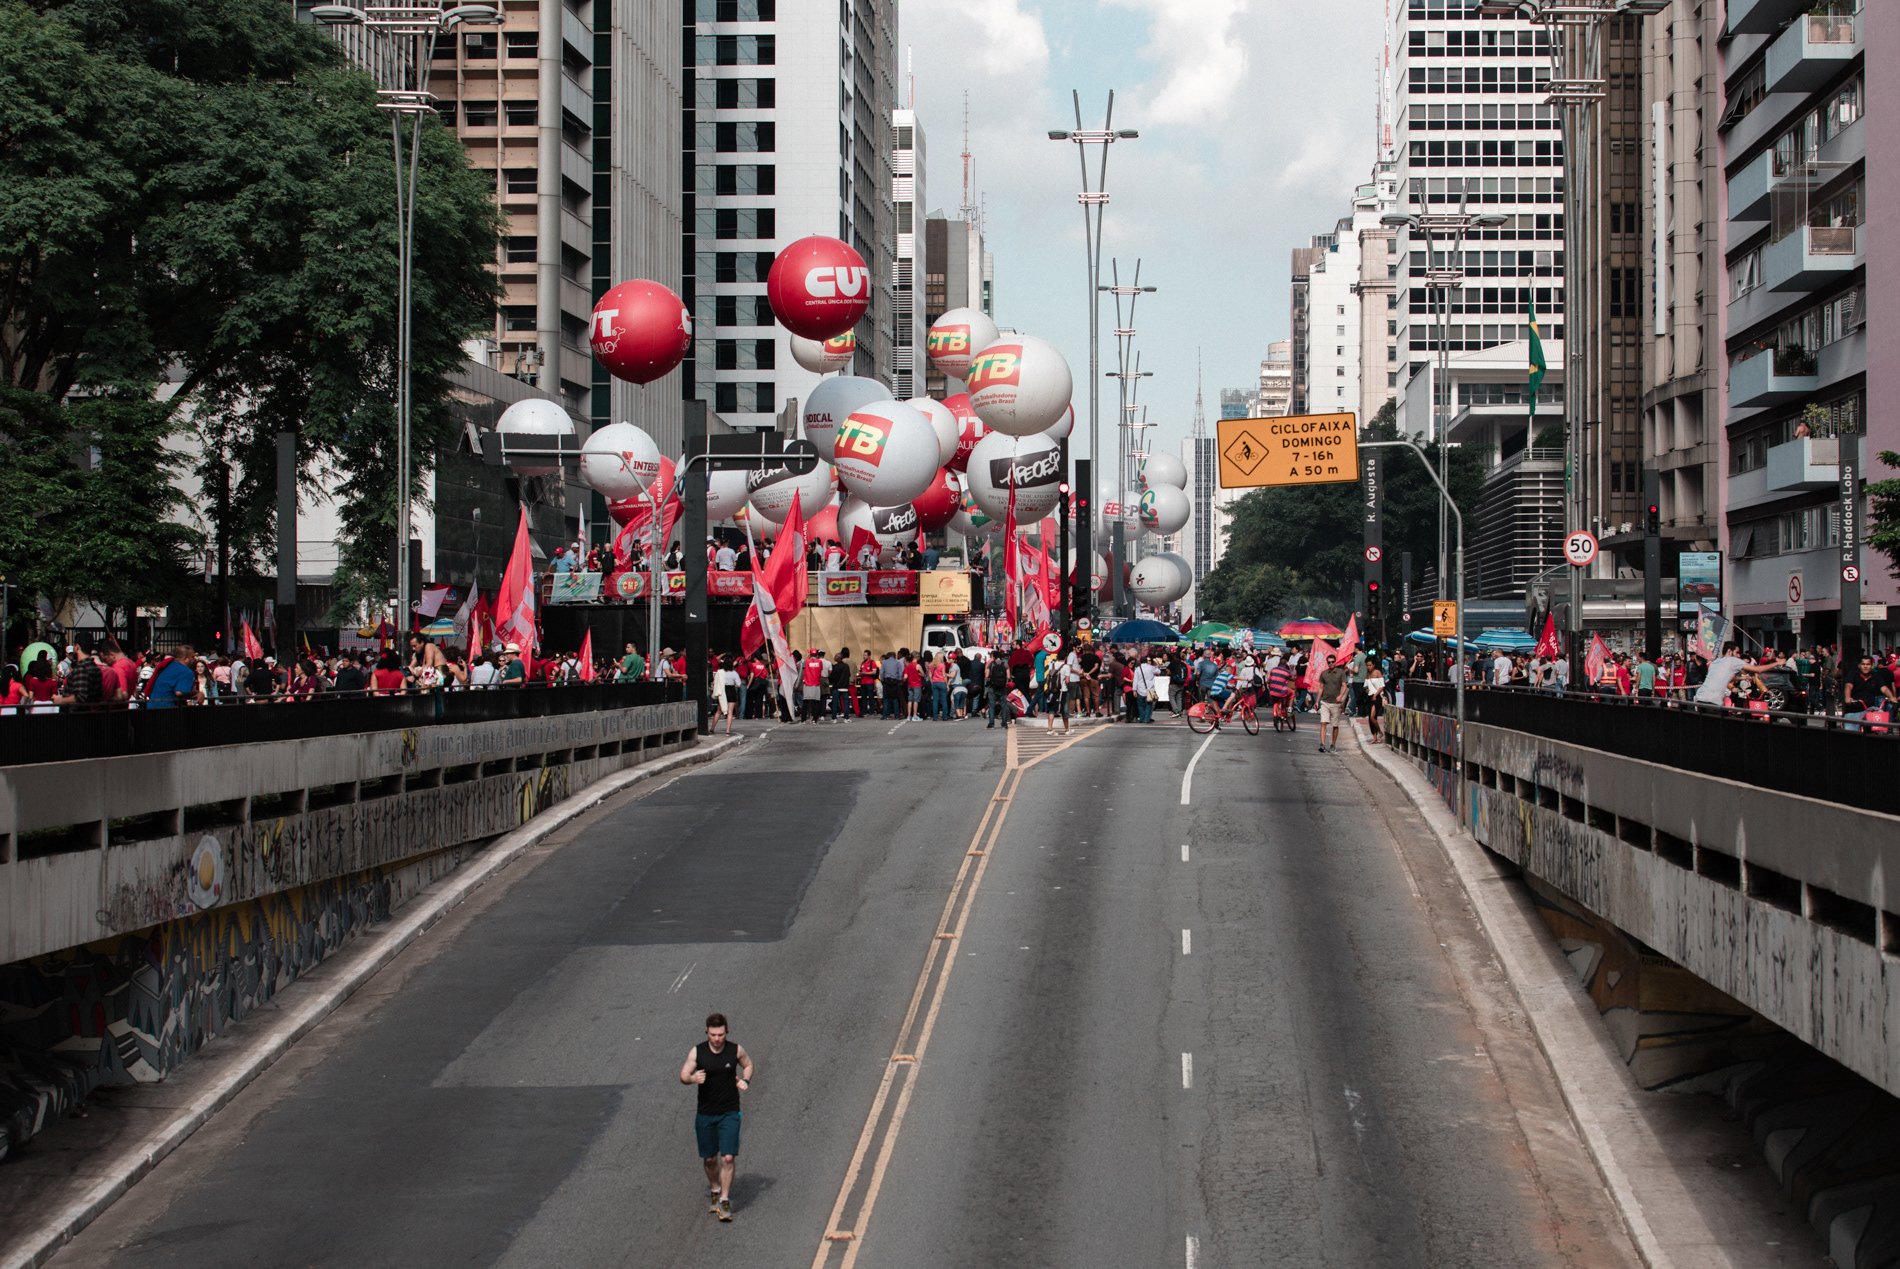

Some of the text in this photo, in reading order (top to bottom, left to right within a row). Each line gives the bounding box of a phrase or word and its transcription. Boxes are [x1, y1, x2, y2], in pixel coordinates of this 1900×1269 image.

[805, 266, 871, 298] CUT
[588, 309, 619, 340] UT
[928, 331, 967, 351] CTB
[958, 416, 984, 438] UT
[1271, 421, 1351, 434] CICLOFAIXA
[1282, 436, 1342, 448] DOMINGO
[1290, 468, 1298, 476] A
[1305, 466, 1322, 475] 50
[856, 474, 872, 482] Brasil
[1366, 459, 1378, 508] Augusta
[1366, 512, 1376, 522] R.
[1842, 466, 1852, 562] R. Haddock Lobo
[1570, 539, 1592, 553] 50
[622, 581, 639, 590] CMP
[716, 576, 745, 587] CUT
[828, 580, 860, 592] CTB
[878, 577, 908, 586] CUT
[434, 734, 453, 765] que
[467, 732, 502, 763] gente
[506, 720, 559, 750] autoriza
[566, 717, 597, 744] fazer
[601, 714, 625, 738] ver
[636, 708, 674, 732] cidade
